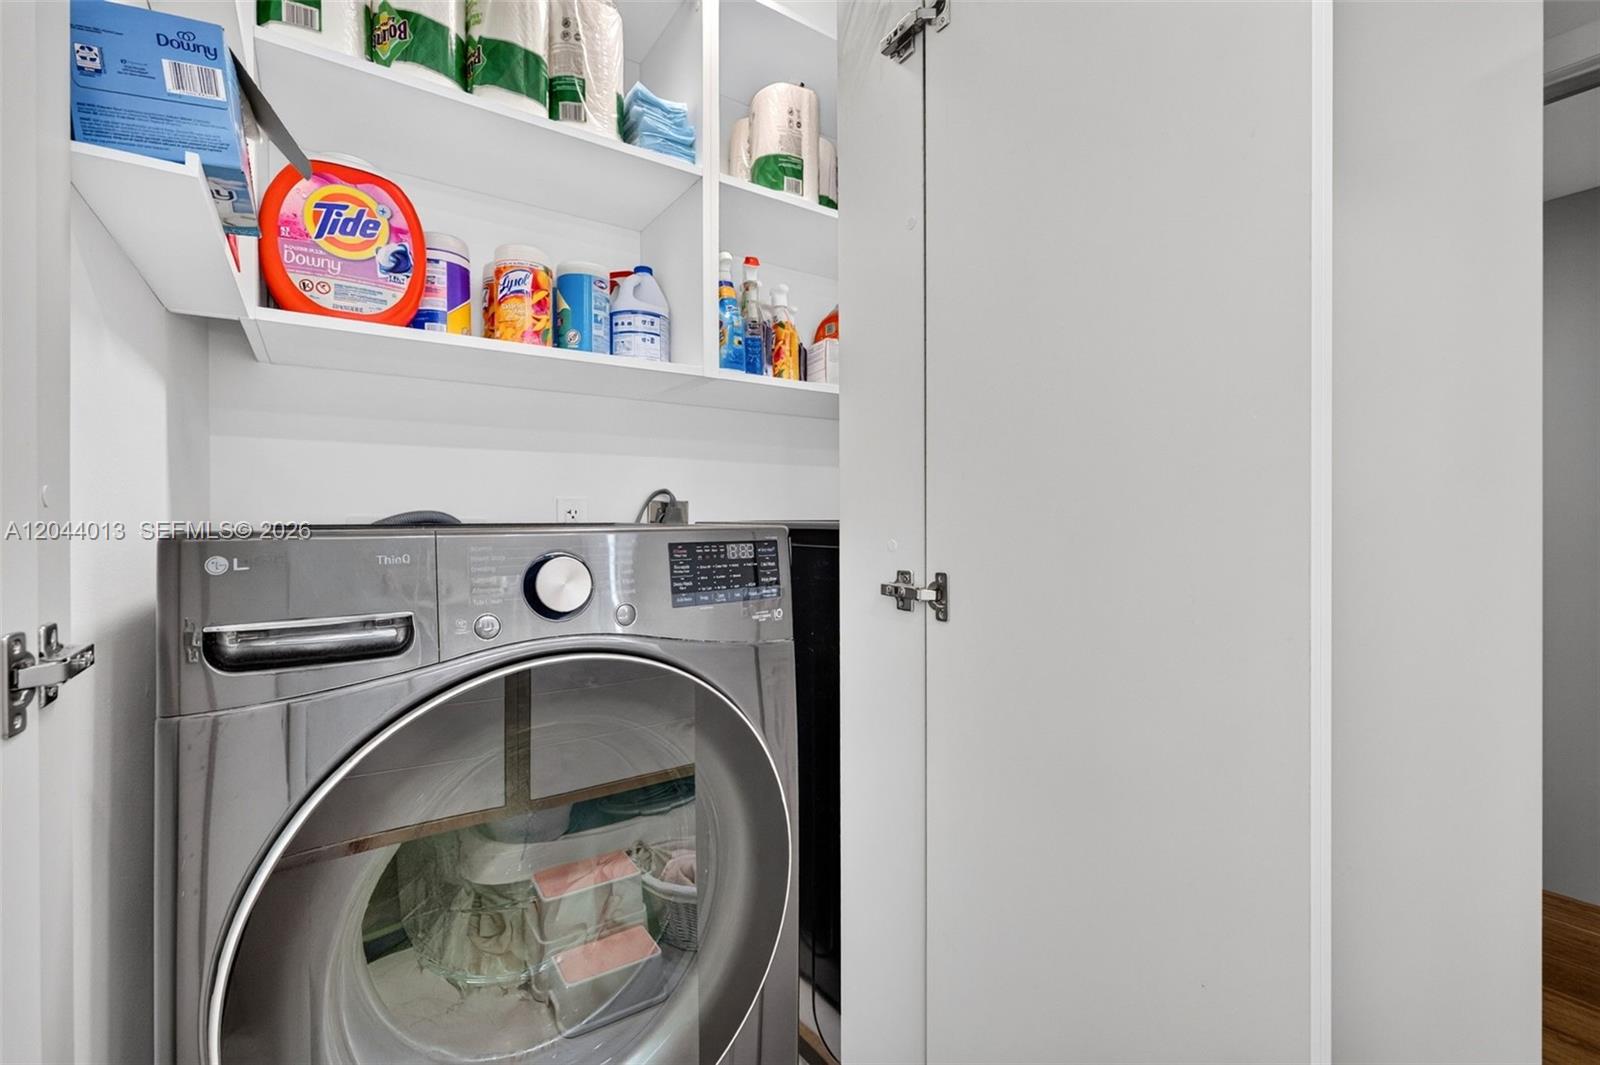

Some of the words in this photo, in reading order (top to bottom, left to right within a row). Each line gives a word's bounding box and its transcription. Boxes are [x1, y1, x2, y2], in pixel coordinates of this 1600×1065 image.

[156, 33, 218, 61] Downy
[313, 202, 381, 240] Tide
[284, 250, 341, 275] Downy
[500, 275, 530, 294] Lysol
[376, 553, 411, 565] ThinQ
